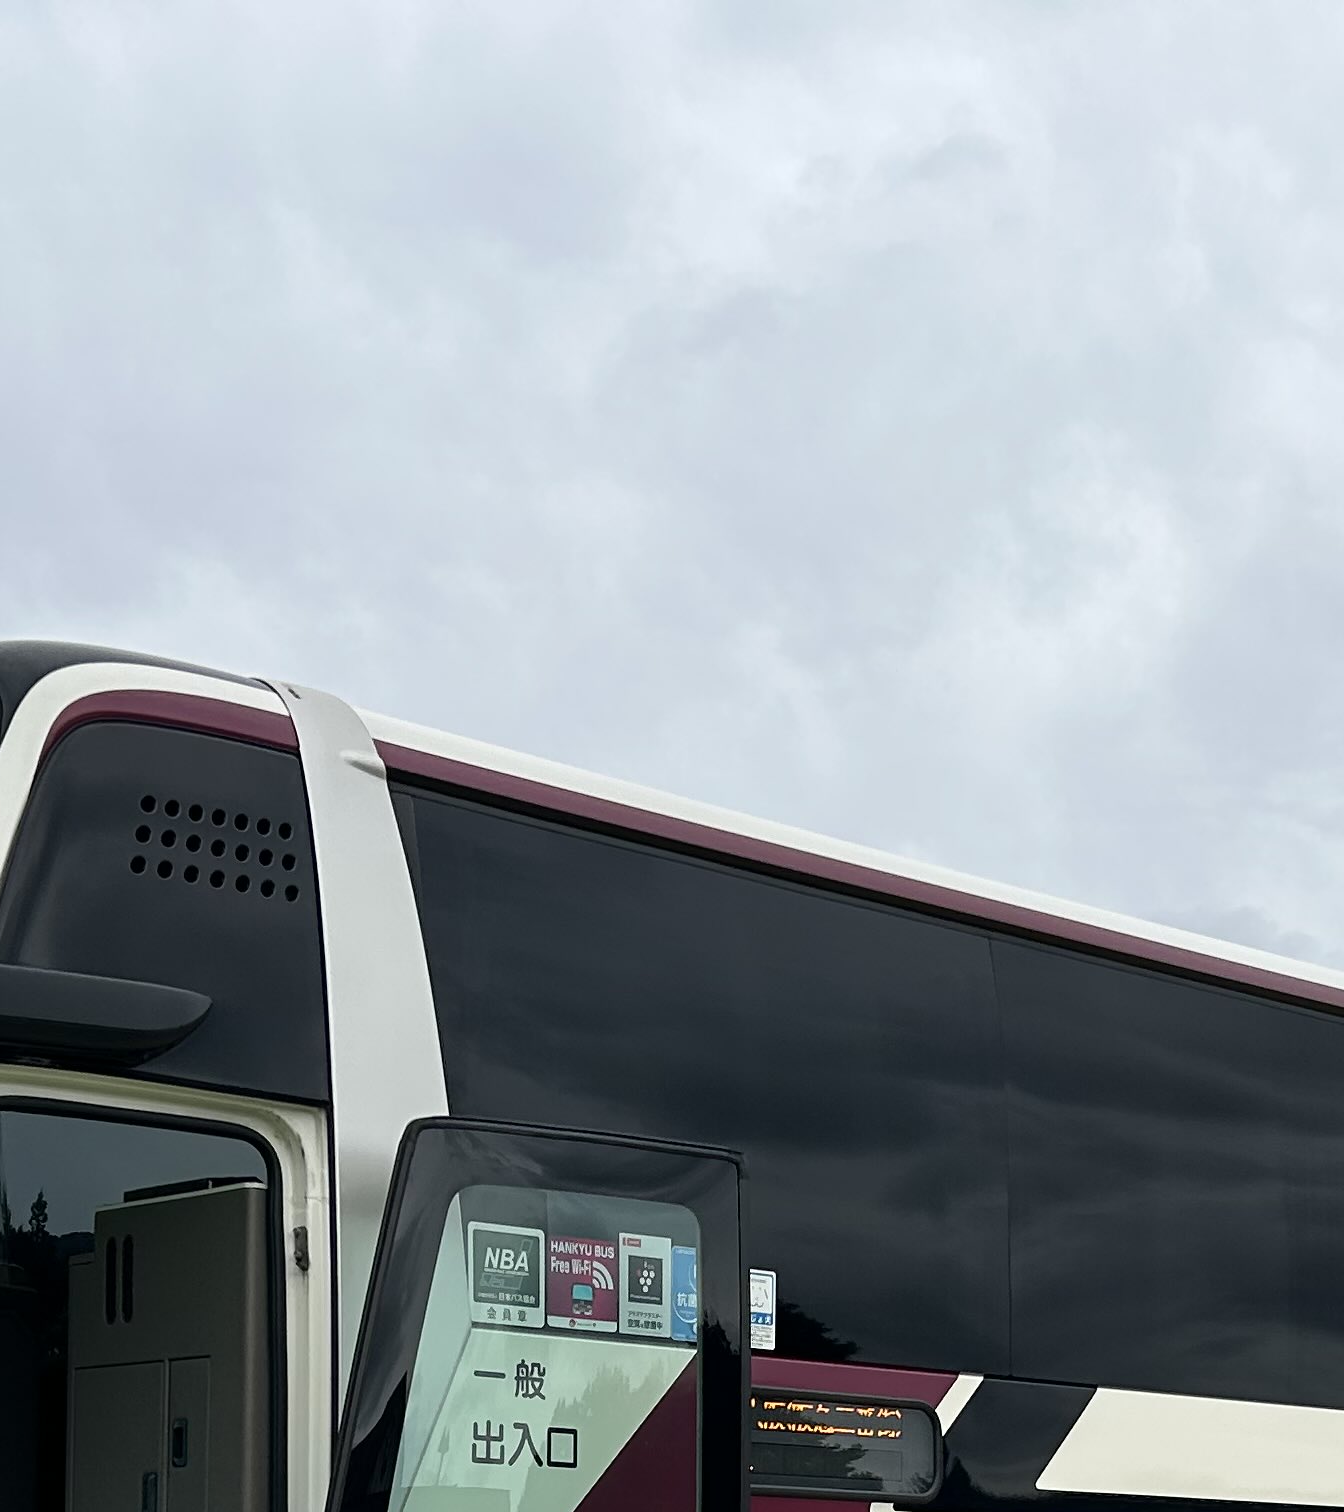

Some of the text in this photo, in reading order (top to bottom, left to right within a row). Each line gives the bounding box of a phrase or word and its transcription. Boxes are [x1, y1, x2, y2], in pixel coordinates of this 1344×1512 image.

[484, 1247, 530, 1272] NBA
[551, 1240, 615, 1259] HANKYU BUS
[550, 1256, 570, 1274] Free
[571, 1259, 592, 1276] Wi-Fi
[473, 1359, 547, 1401] 一般
[471, 1419, 579, 1469] 出入口
